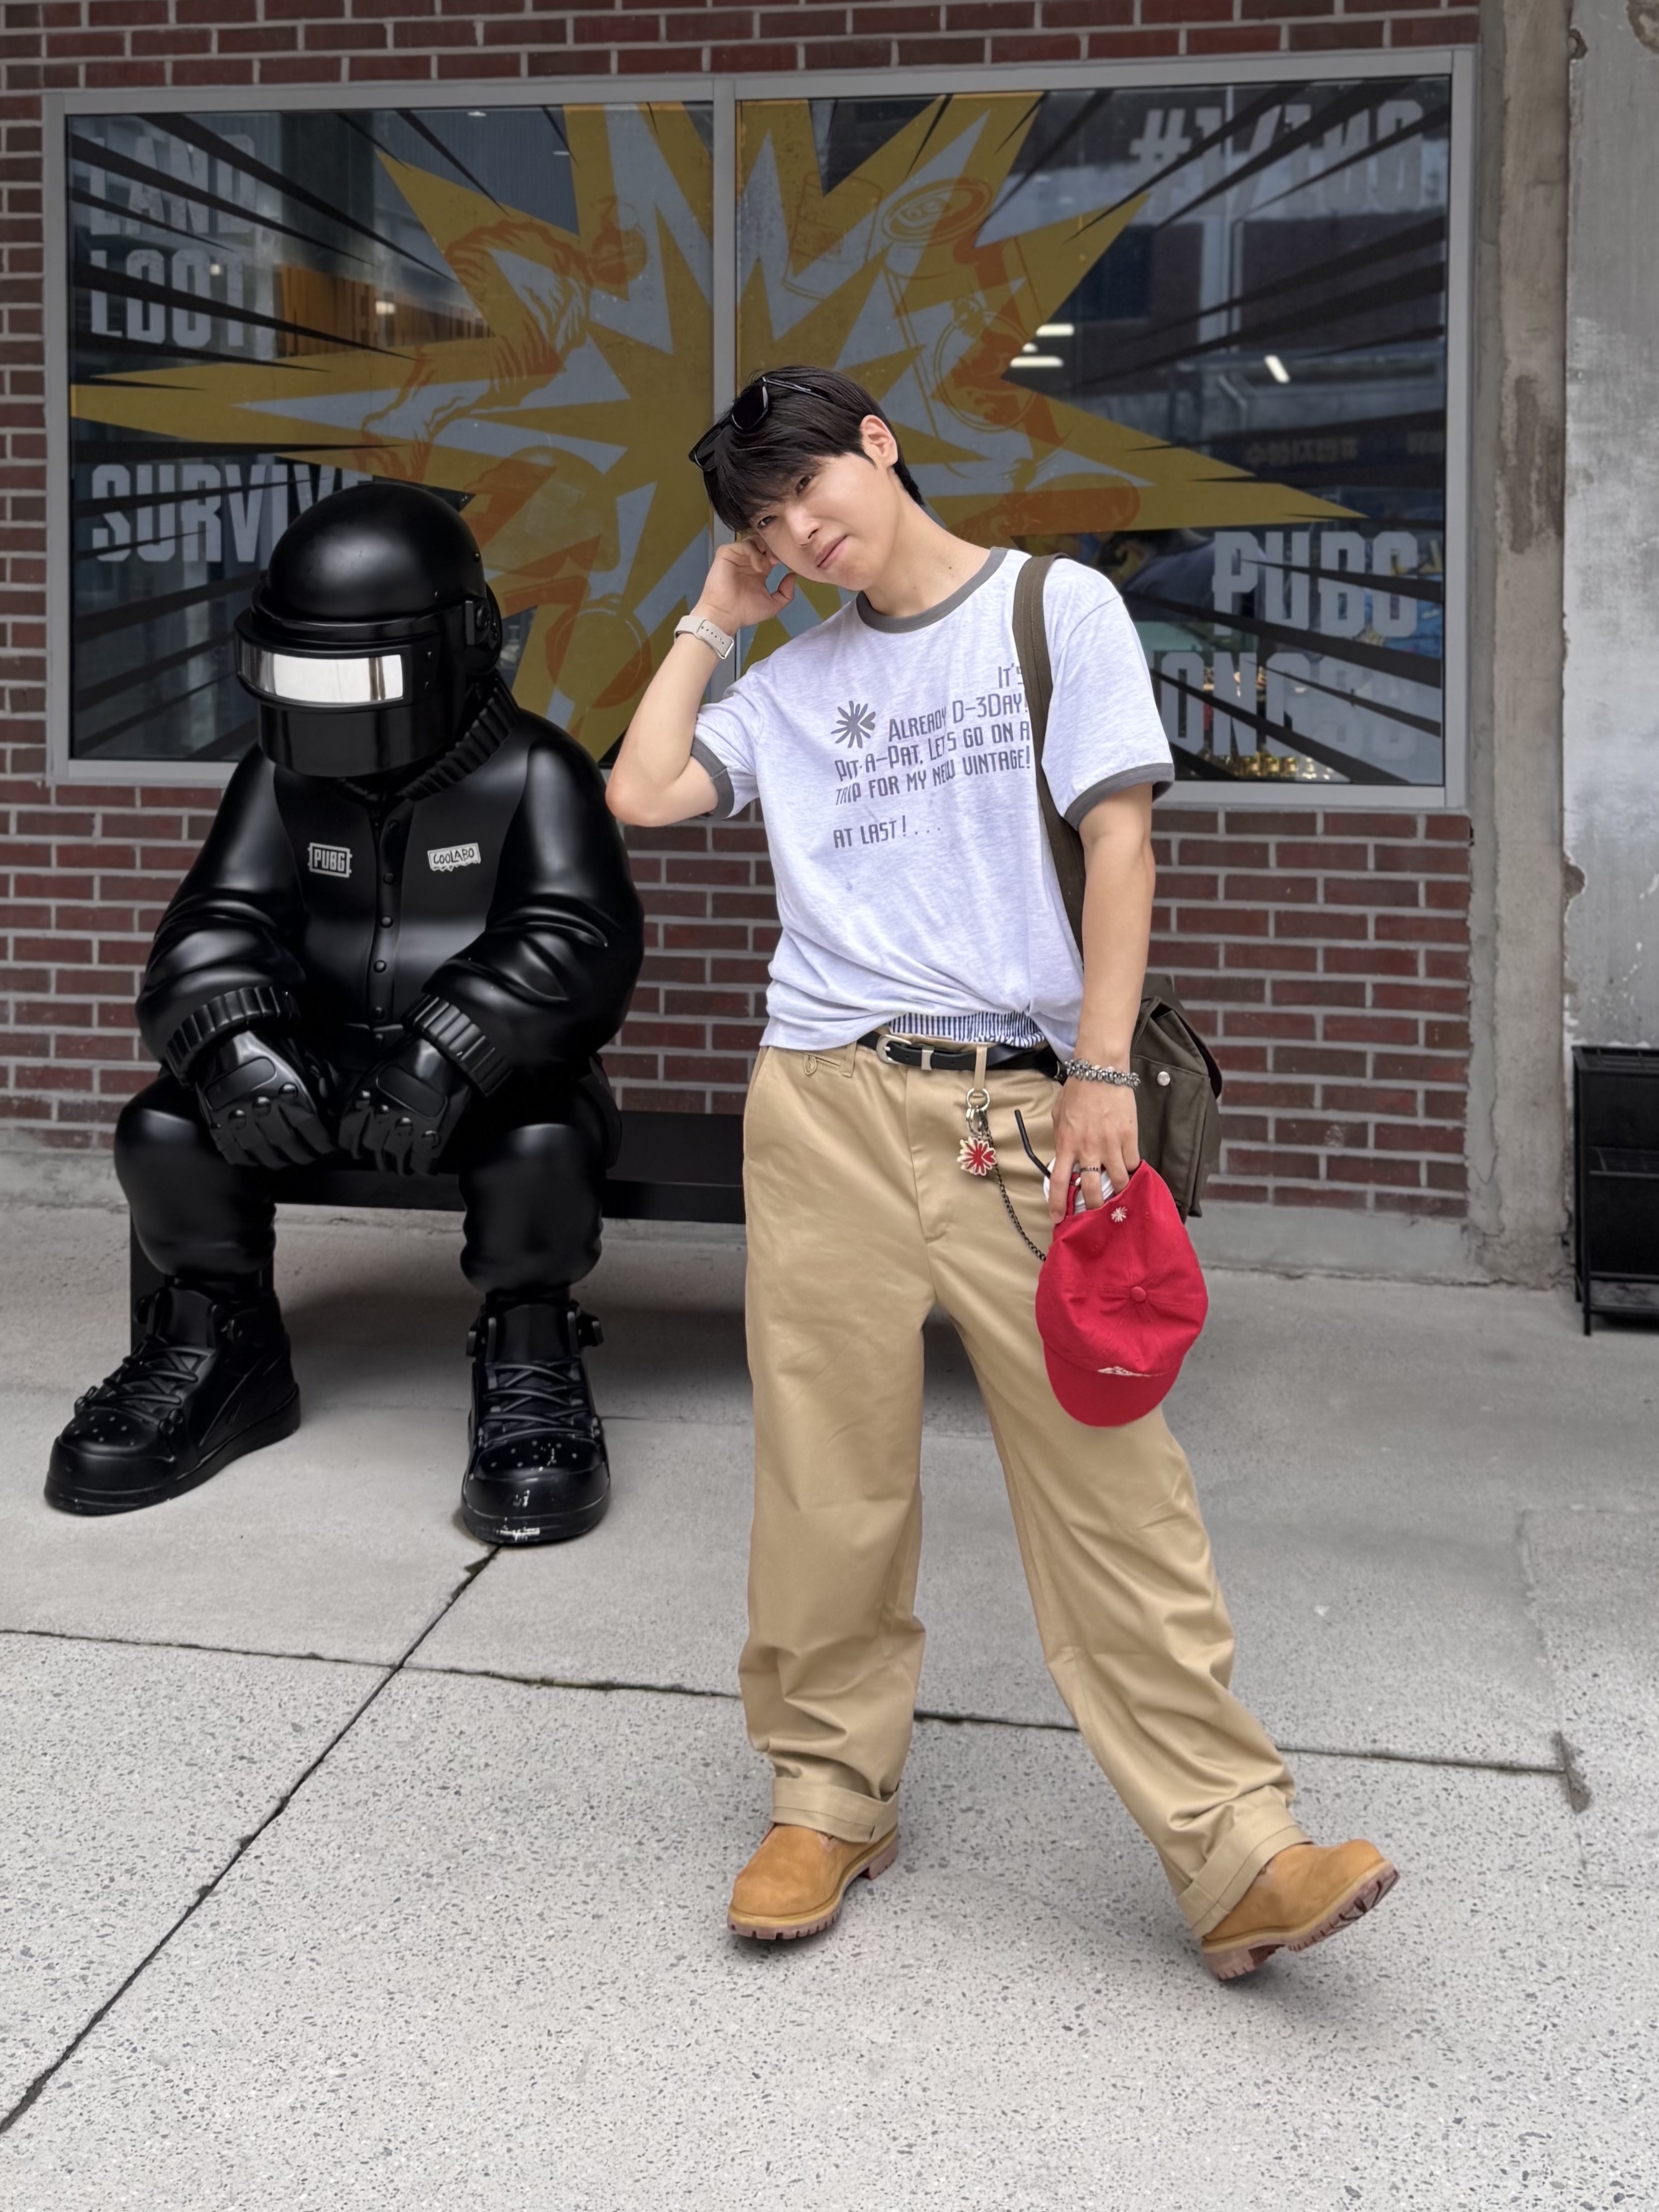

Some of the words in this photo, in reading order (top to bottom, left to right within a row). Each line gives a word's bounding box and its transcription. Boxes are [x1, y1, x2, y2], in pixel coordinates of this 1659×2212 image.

[90, 133, 256, 236] LAND
[90, 249, 256, 348] LOOT
[91, 463, 373, 563] SURVIV
[1211, 531, 1418, 637] PUBG
[889, 706, 946, 742] ALREADY
[963, 726, 984, 749] GO
[991, 722, 1014, 744] ON
[1020, 721, 1030, 741] A
[835, 782, 862, 806] TRIP
[868, 775, 900, 799] FOR
[906, 770, 927, 792] MY
[932, 759, 956, 787] NEW
[961, 745, 1031, 777] VINTAGE!
[313, 848, 346, 872] PUBG
[433, 847, 475, 864] COOLABO
[833, 828, 853, 849] AT
